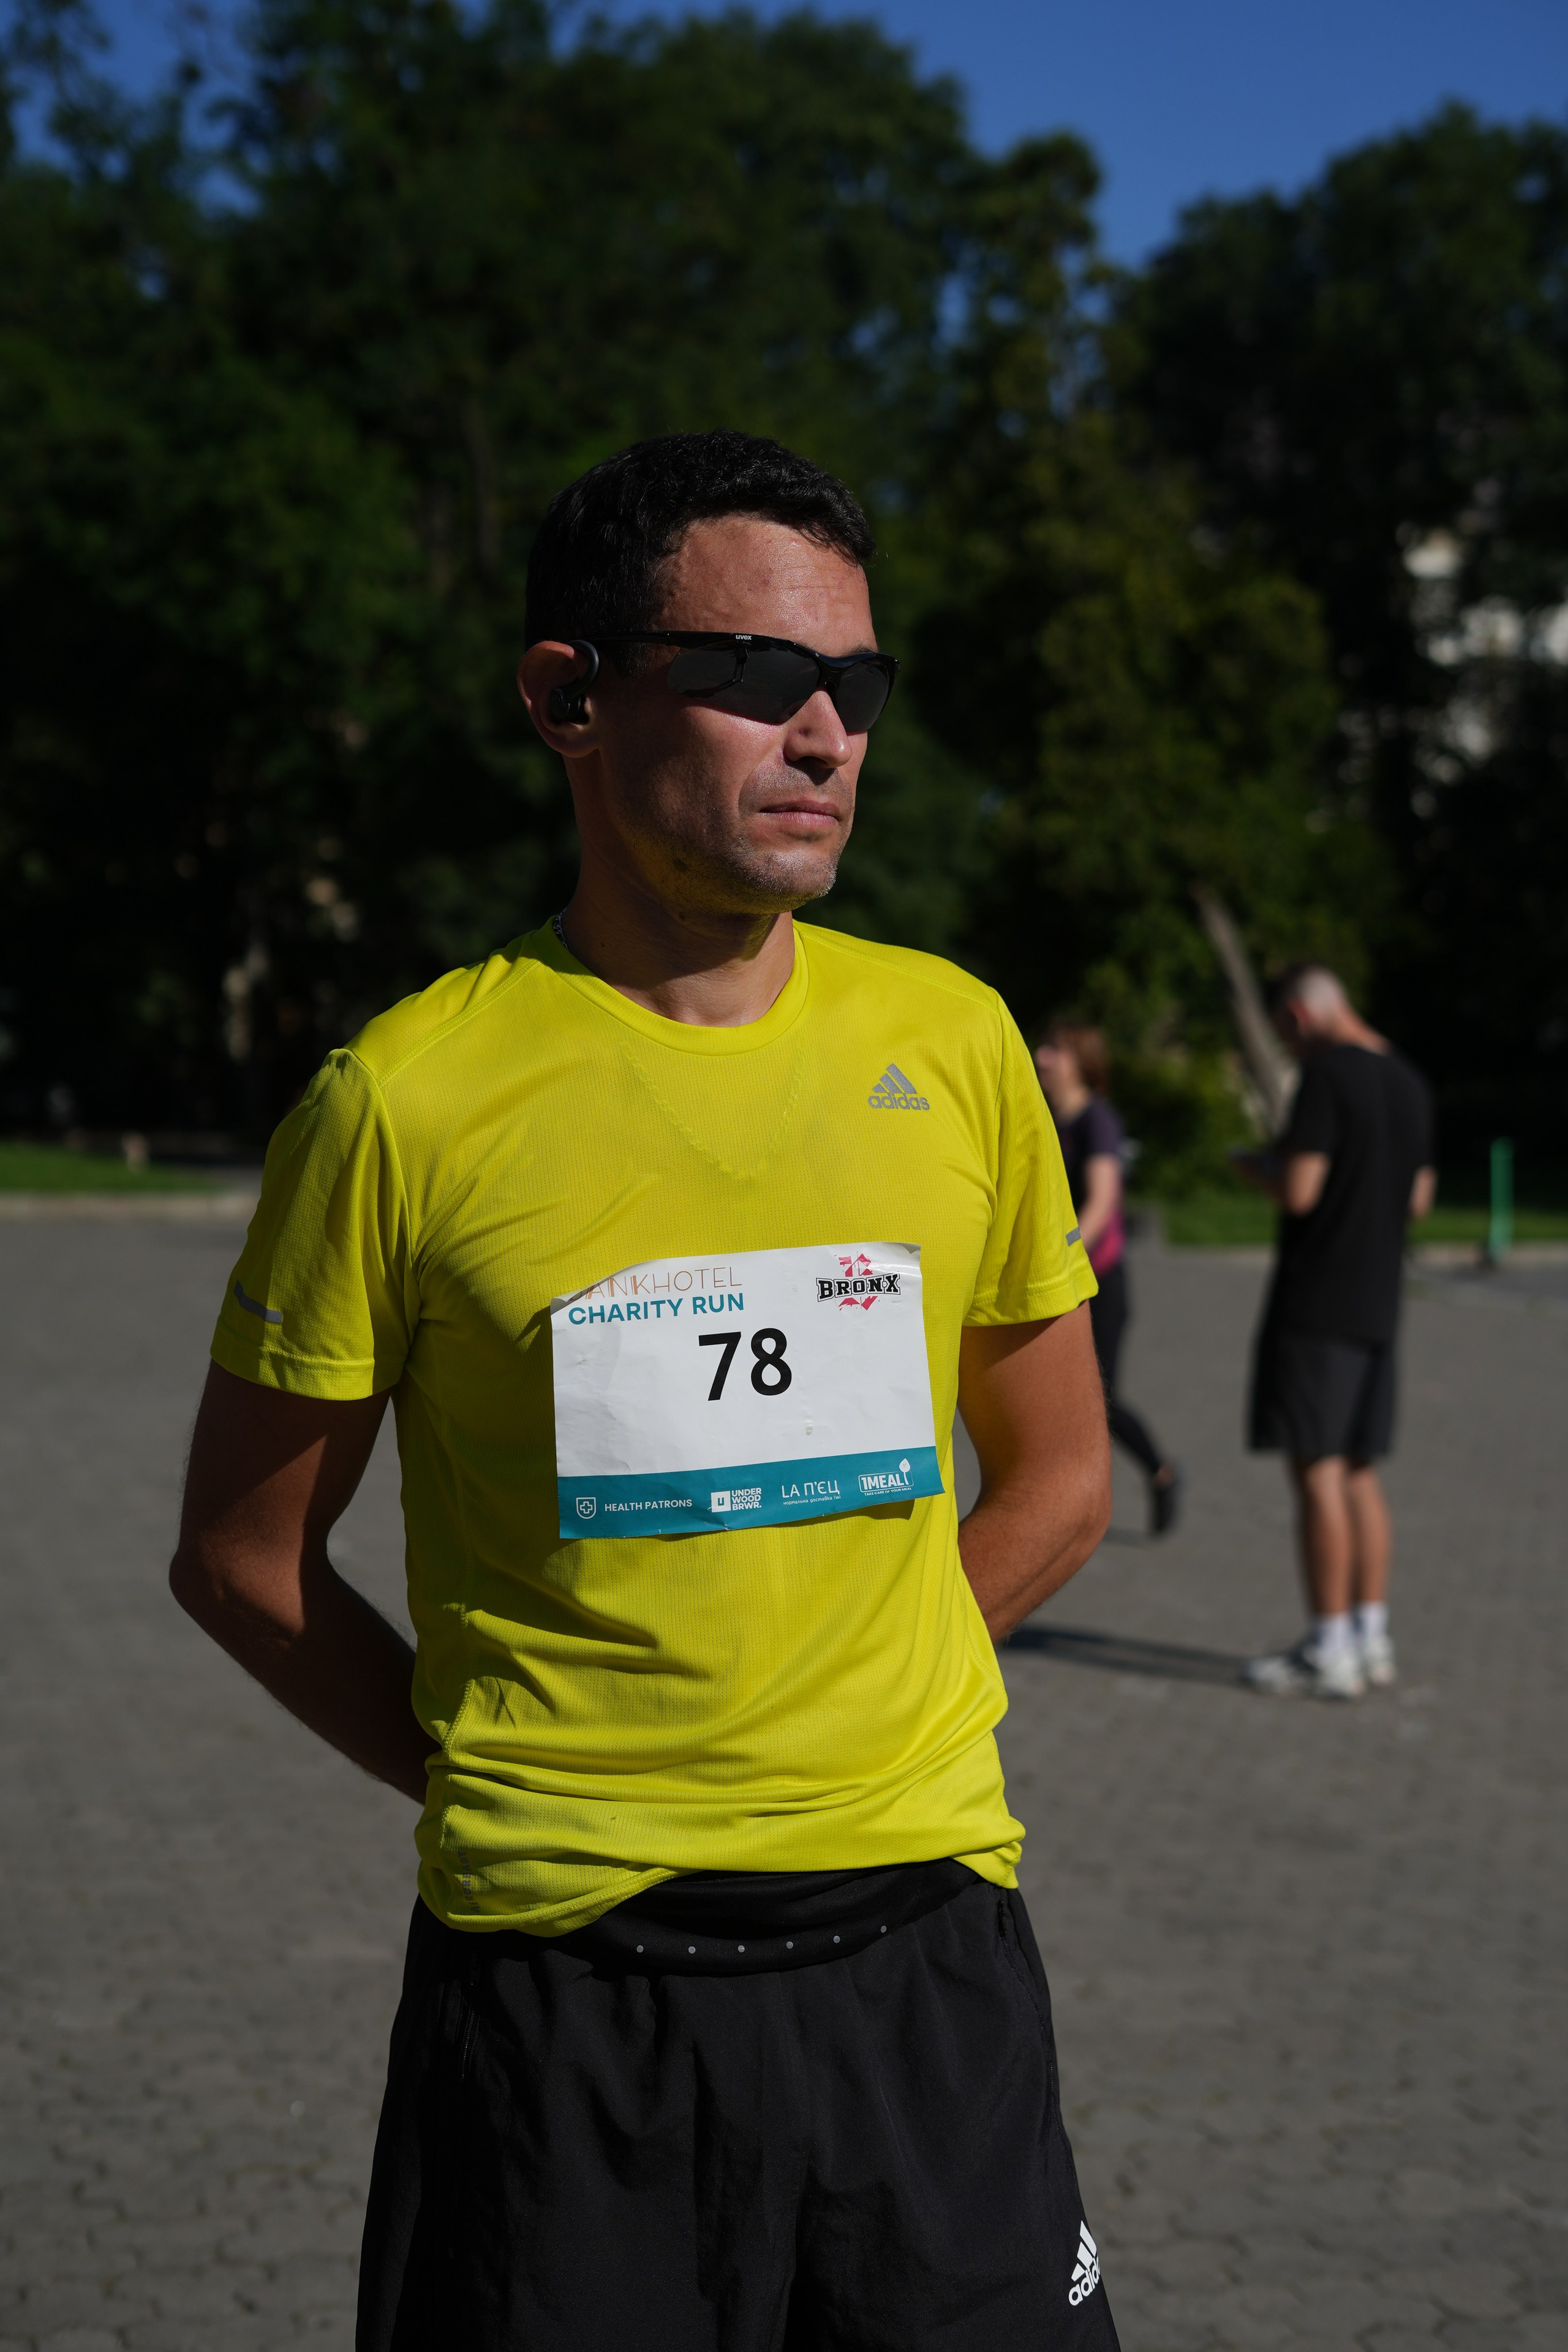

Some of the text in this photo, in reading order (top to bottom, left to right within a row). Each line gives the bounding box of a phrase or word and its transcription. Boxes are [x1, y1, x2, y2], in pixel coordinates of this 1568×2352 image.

[868, 1092, 930, 1110] adidas
[816, 1272, 901, 1302] BRONX
[568, 1292, 744, 1325] CHARITY RUN
[698, 1327, 792, 1401] 78
[861, 1473, 905, 1490] 1MEAL
[731, 1487, 762, 1497] UNDER
[731, 1494, 761, 1504] WOOD
[782, 1483, 801, 1498] LA
[605, 1499, 693, 1512] HEALTH PATRONS
[732, 1501, 762, 1511] BRWR.
[1069, 2256, 1100, 2305] adid
